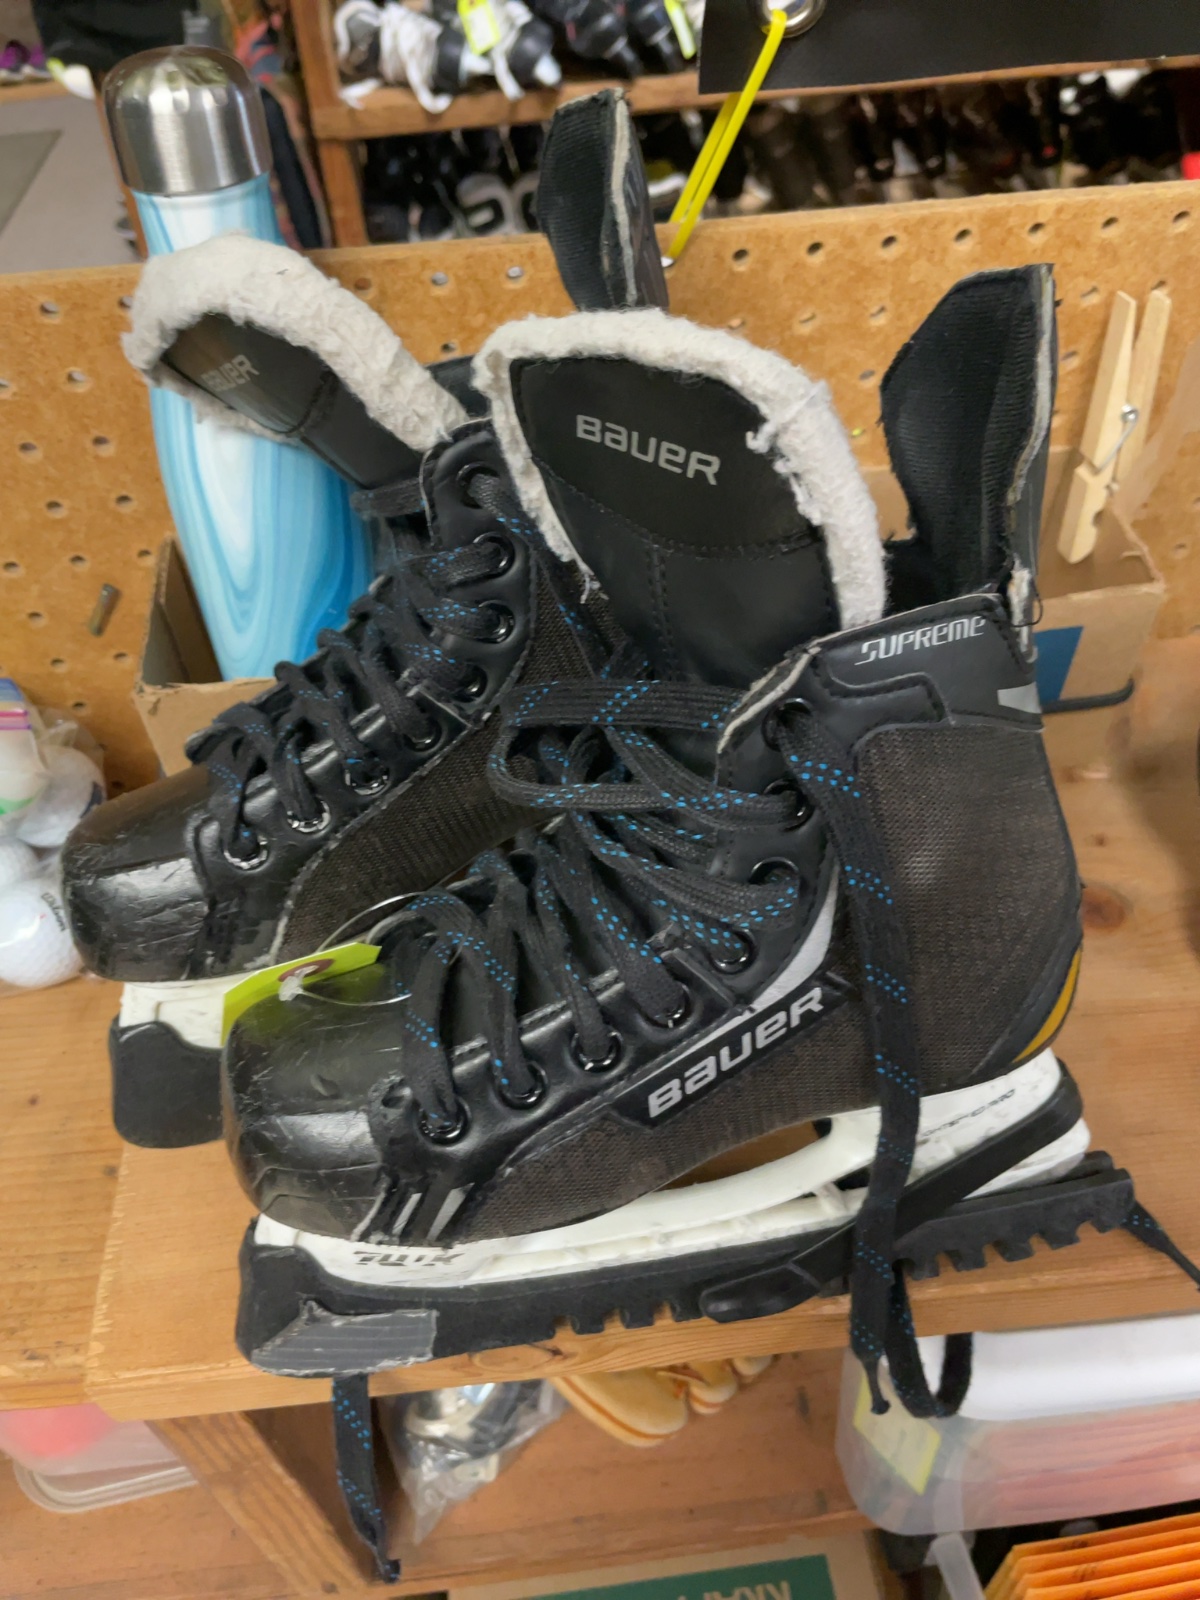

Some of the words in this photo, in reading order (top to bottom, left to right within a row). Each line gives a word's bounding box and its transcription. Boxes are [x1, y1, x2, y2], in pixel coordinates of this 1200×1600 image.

[576, 414, 721, 486] BAUER
[854, 615, 986, 666] SUPREME
[647, 987, 824, 1118] BAUER
